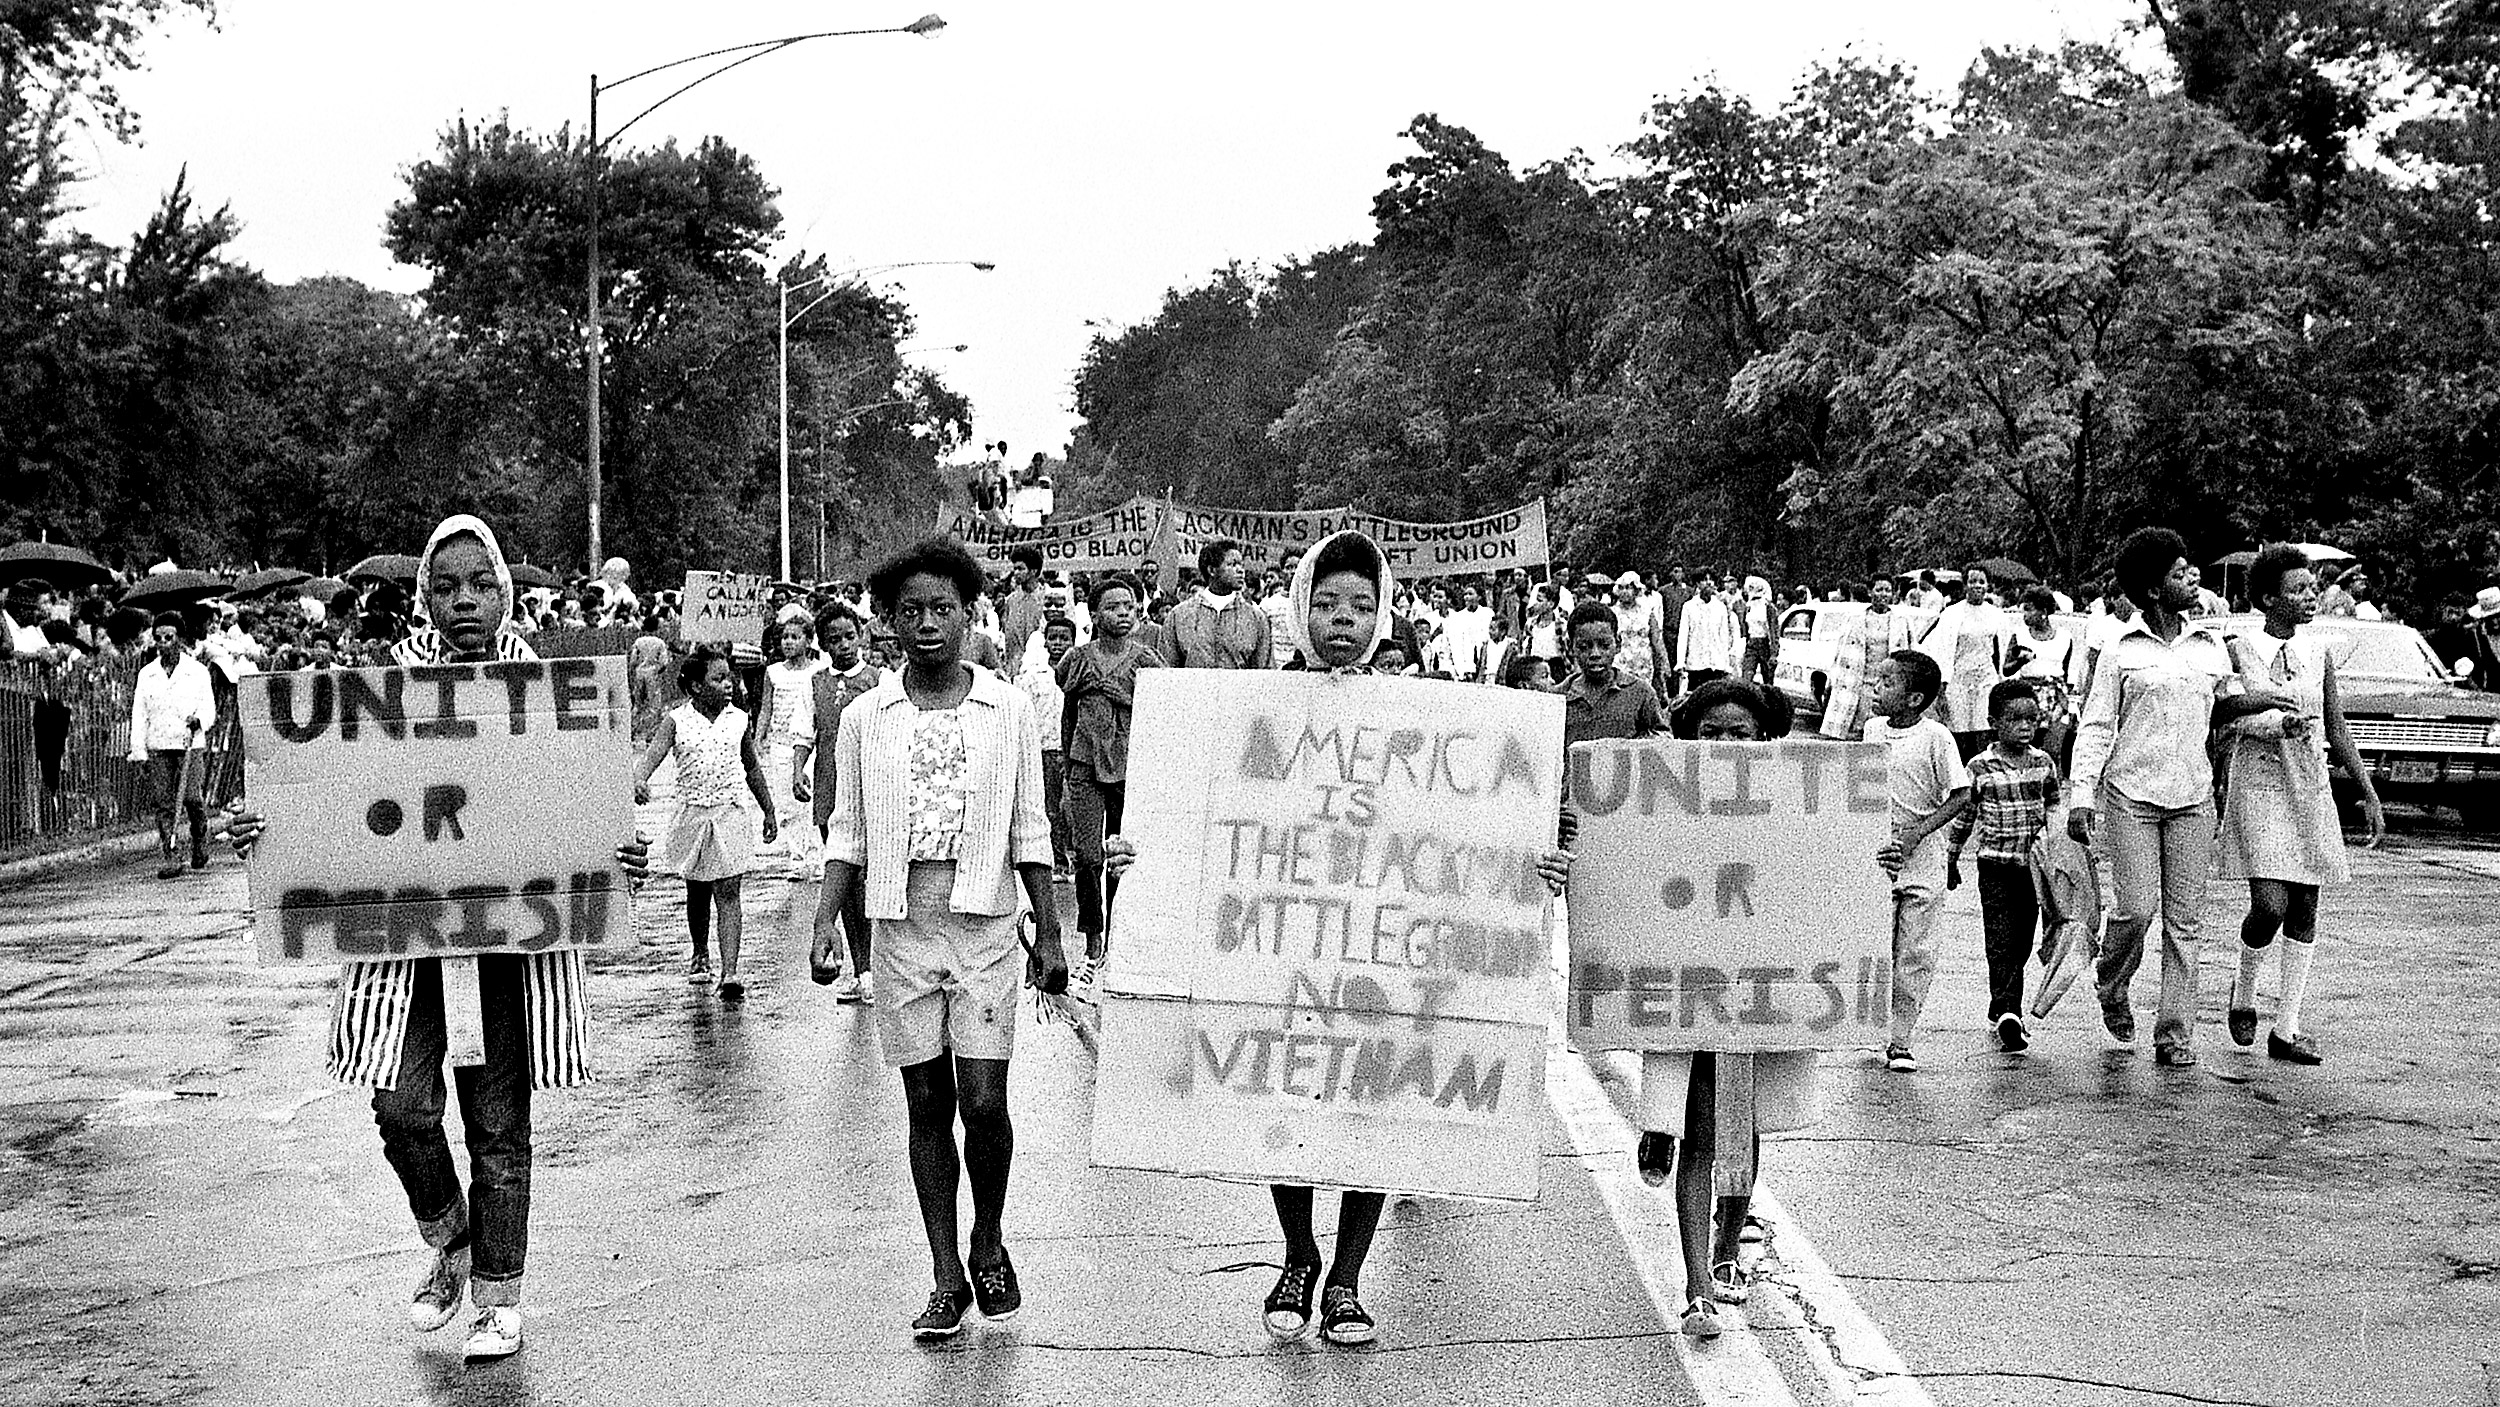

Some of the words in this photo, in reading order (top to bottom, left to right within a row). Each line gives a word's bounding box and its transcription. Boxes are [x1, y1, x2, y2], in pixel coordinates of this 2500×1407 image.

[1104, 505, 1147, 534] THE
[1434, 538, 1517, 564] UNION
[267, 660, 599, 744] UNITE
[1237, 715, 1541, 798] AMERICA
[1570, 743, 1888, 816] UNITE
[366, 784, 467, 841] OR
[1310, 783, 1379, 827] IS
[1216, 818, 1314, 887] THE
[1660, 861, 1755, 919] OR
[1283, 969, 1458, 1032] NOT
[1196, 1028, 1507, 1113] VIETNAM
